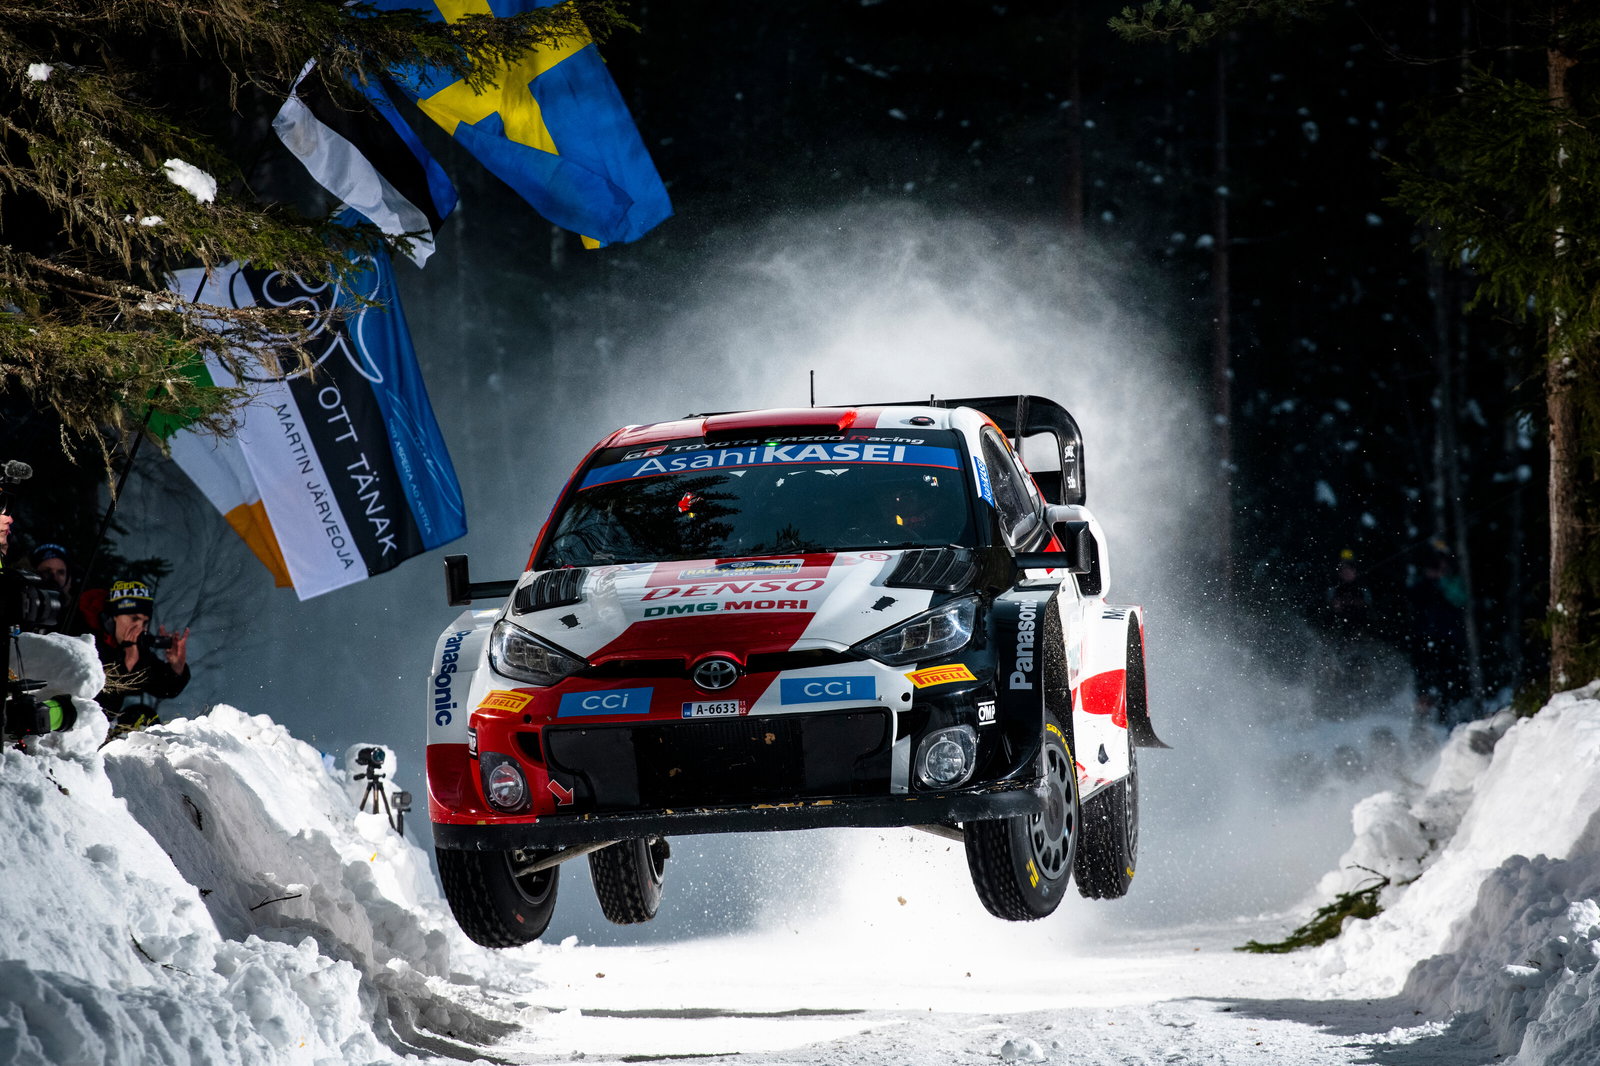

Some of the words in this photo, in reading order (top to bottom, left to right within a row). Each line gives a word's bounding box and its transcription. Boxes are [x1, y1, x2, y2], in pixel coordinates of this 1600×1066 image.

[624, 447, 664, 460] GR
[671, 438, 758, 453] TOYOTA
[850, 434, 925, 445] Racing
[318, 386, 358, 442] OTT
[347, 452, 397, 557] TÄNAK
[277, 403, 313, 475] MARTIN
[306, 481, 355, 570] JÄRVEOJA
[640, 579, 825, 602] DENSO
[643, 602, 719, 618] DMG
[724, 599, 809, 611] MORI
[912, 666, 970, 685] PIRELLI
[483, 692, 528, 709] PIRELLI
[696, 702, 736, 716] A-6633
[978, 705, 996, 721] OMP
